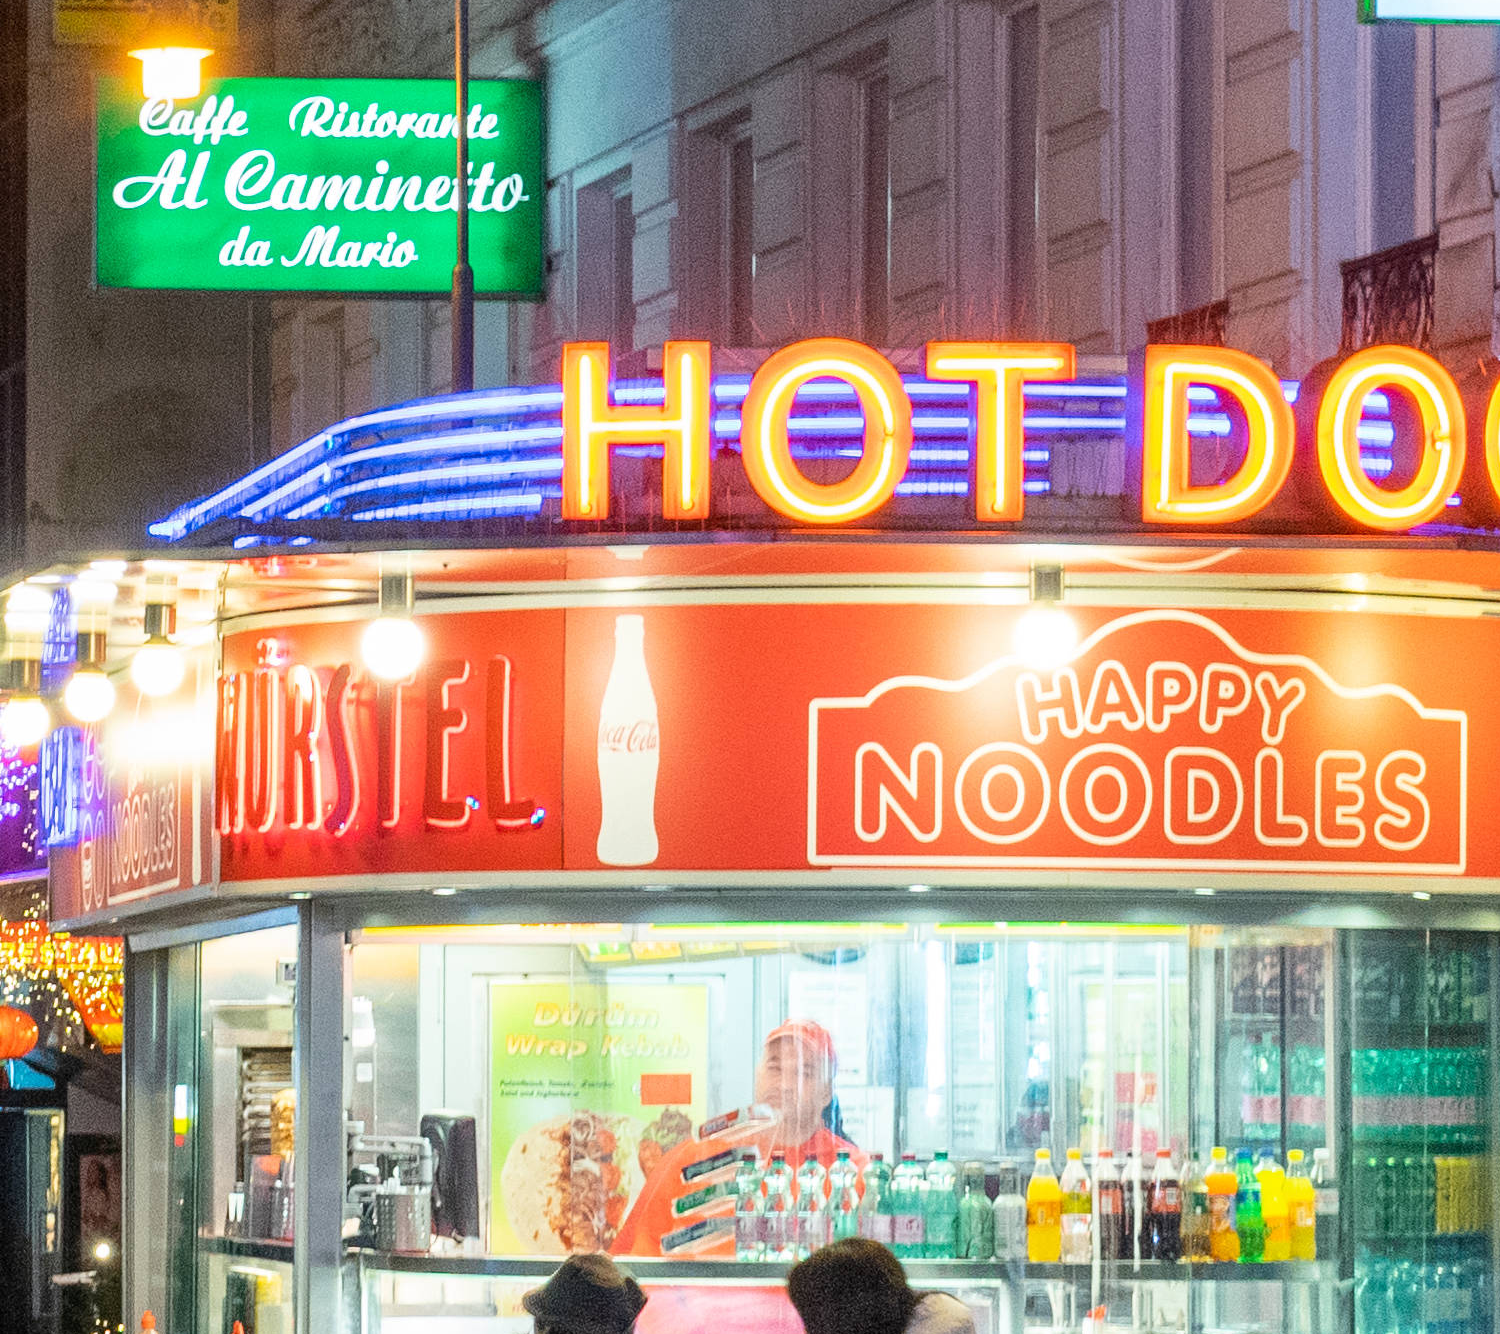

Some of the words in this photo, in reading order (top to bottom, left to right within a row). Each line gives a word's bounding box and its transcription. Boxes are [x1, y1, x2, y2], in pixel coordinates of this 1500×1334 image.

[138, 94, 249, 146] Caffe
[288, 95, 500, 140] Ristorante
[111, 148, 211, 211] Al
[218, 224, 274, 267] da
[280, 224, 419, 268] Mario
[561, 337, 1077, 526] HOT
[1015, 660, 1306, 745] HAPPY
[854, 741, 1431, 851] NOODLES
[532, 1001, 661, 1028] Dürüm
[505, 1033, 589, 1061] Wrap
[600, 1034, 691, 1060] Kebab
